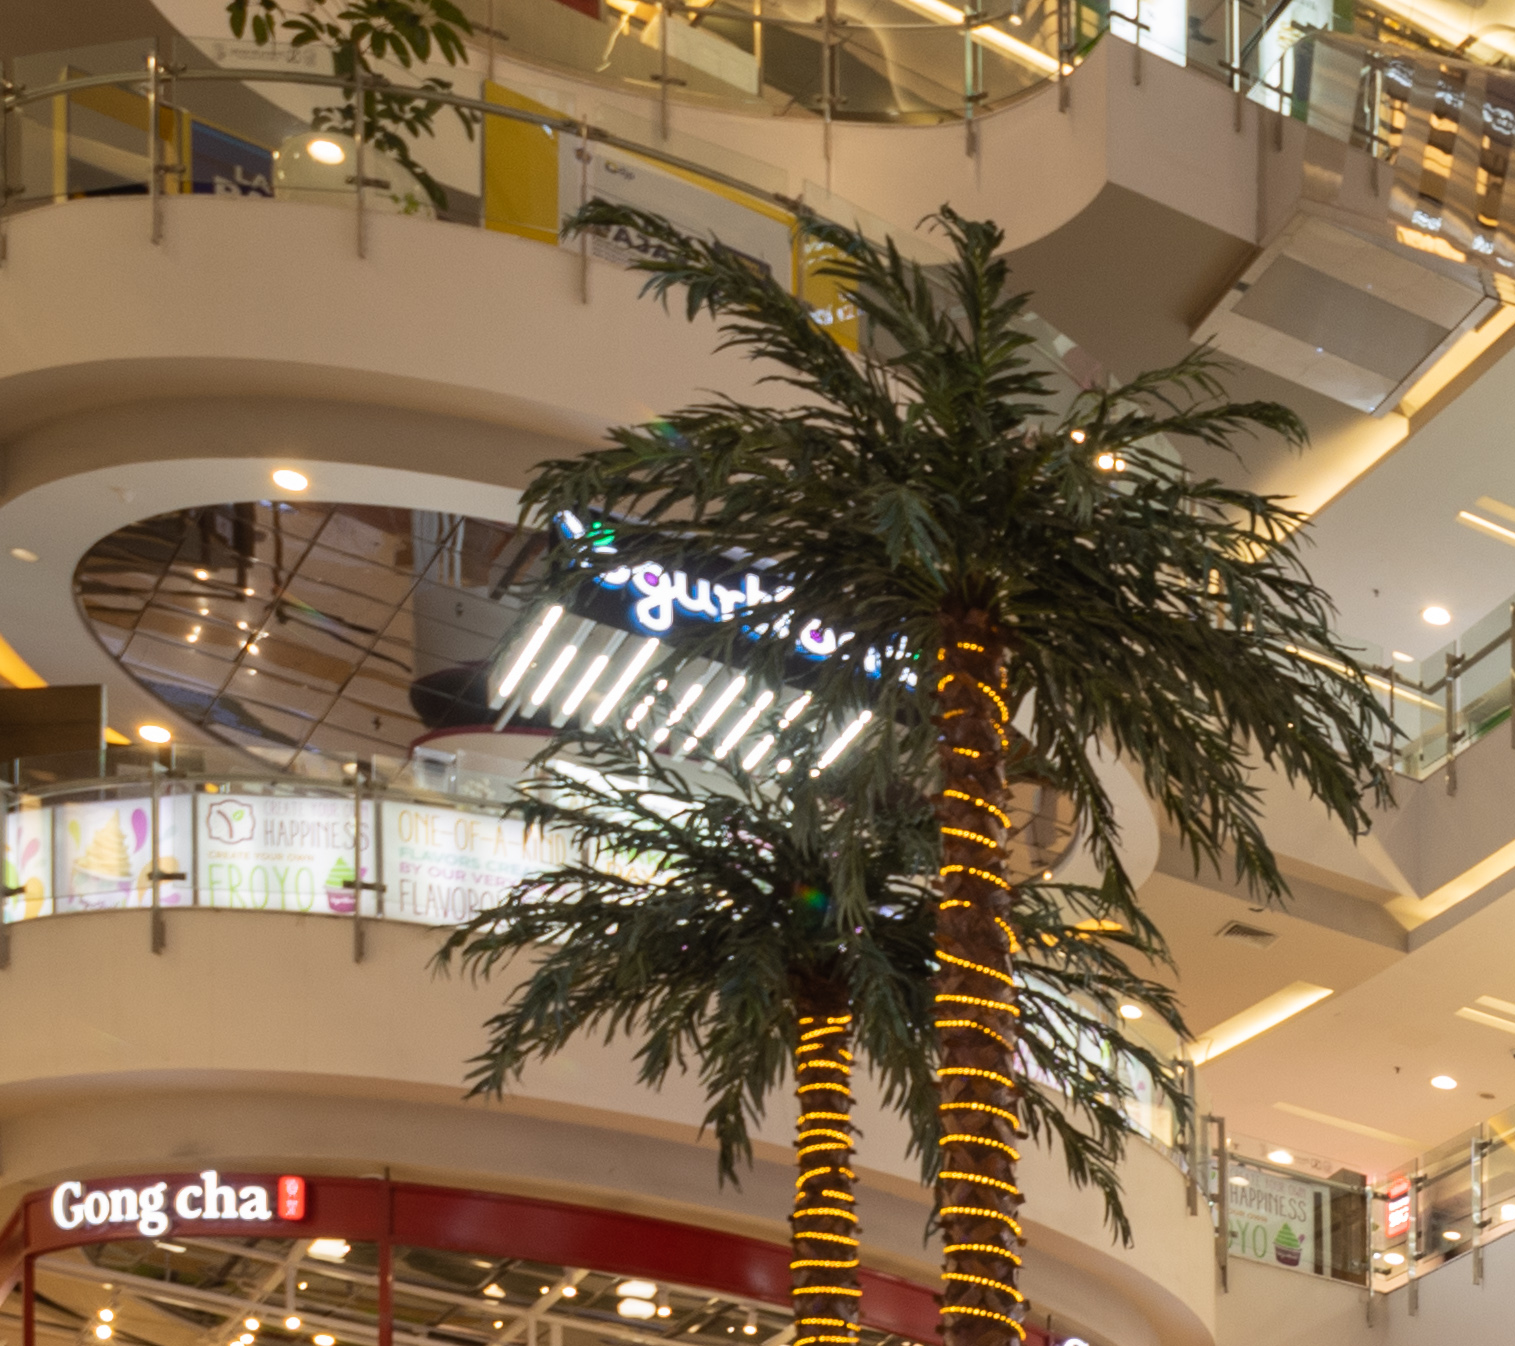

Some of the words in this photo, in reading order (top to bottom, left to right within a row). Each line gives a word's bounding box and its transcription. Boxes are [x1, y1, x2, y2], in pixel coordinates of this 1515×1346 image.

[207, 862, 315, 913] FROYO
[52, 1181, 168, 1237] Gong
[174, 1169, 272, 1220] cha
